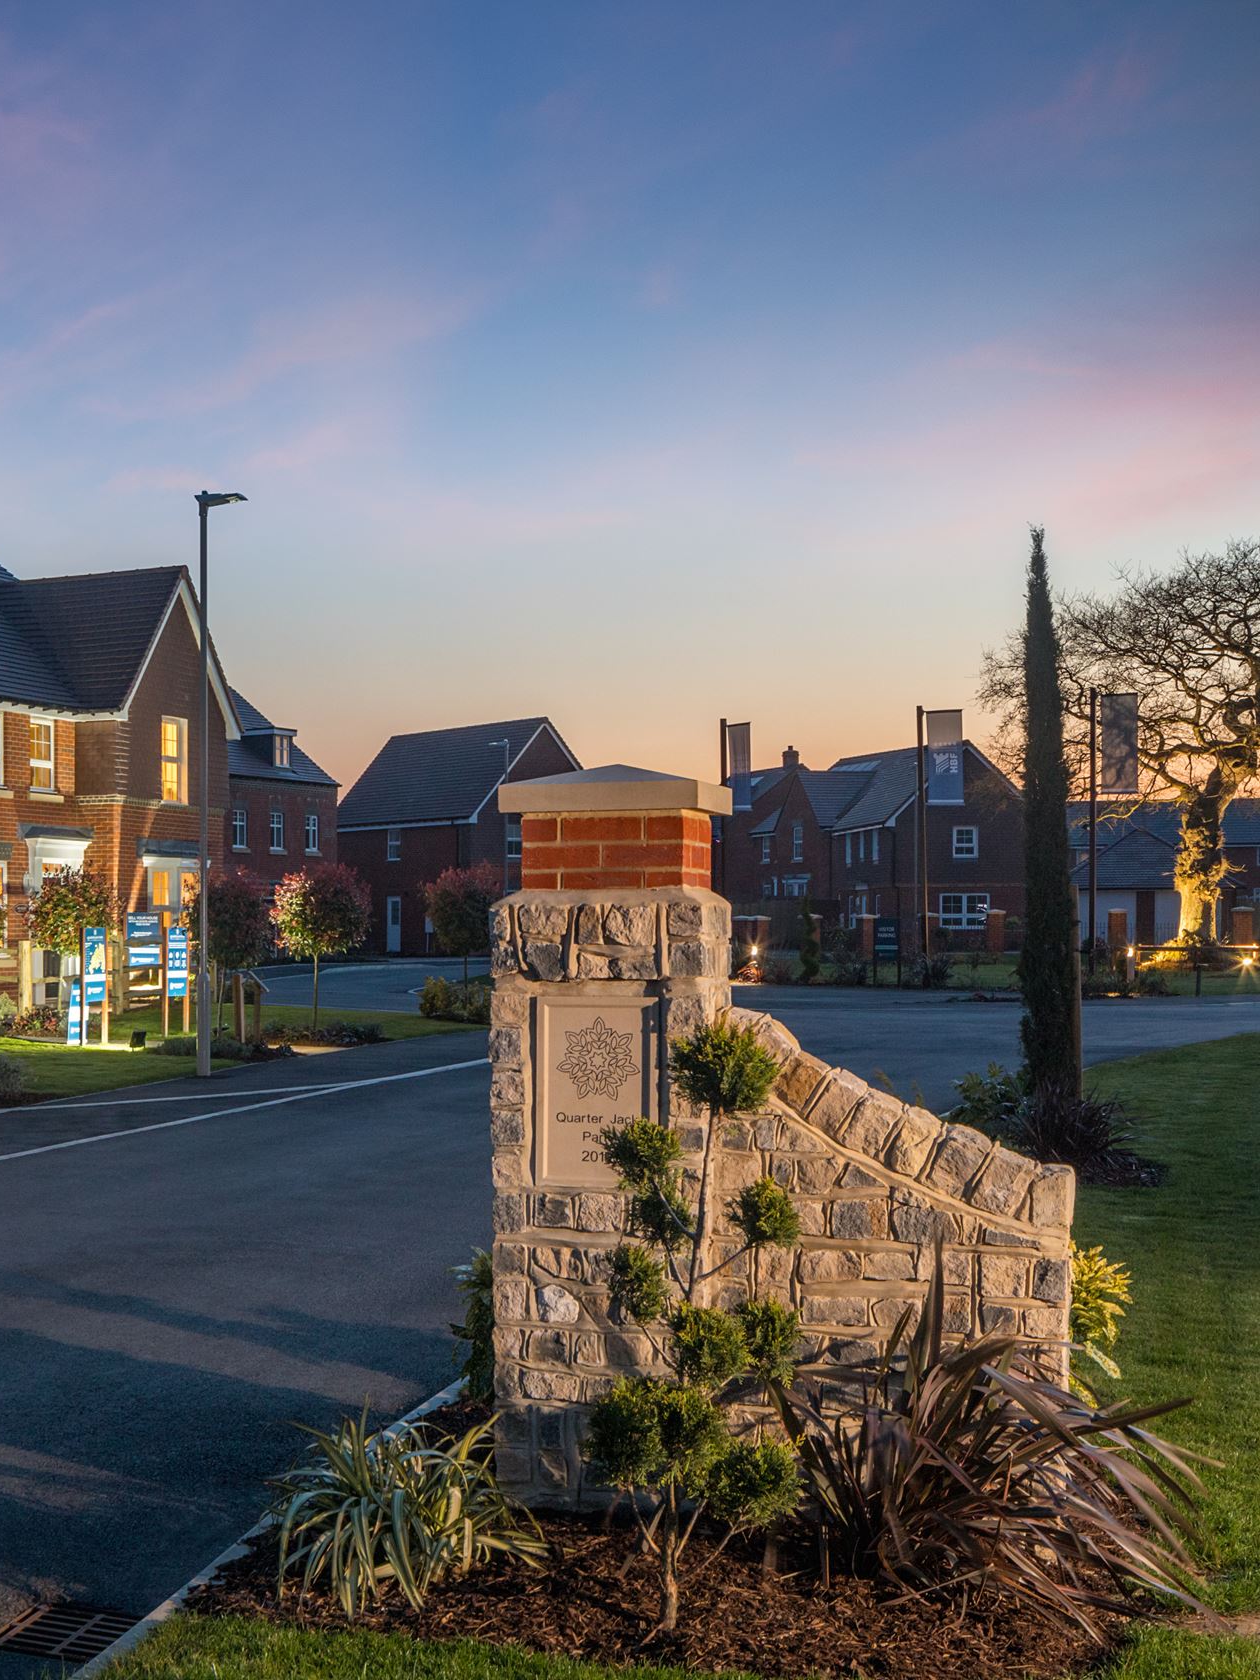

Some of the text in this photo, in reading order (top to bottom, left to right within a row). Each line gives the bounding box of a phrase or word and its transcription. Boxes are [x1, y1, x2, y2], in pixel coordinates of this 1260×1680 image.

[949, 753, 958, 773] HBF
[556, 1112, 603, 1123] Quarter
[582, 1131, 607, 1142] Par
[582, 1150, 605, 1162] 201
